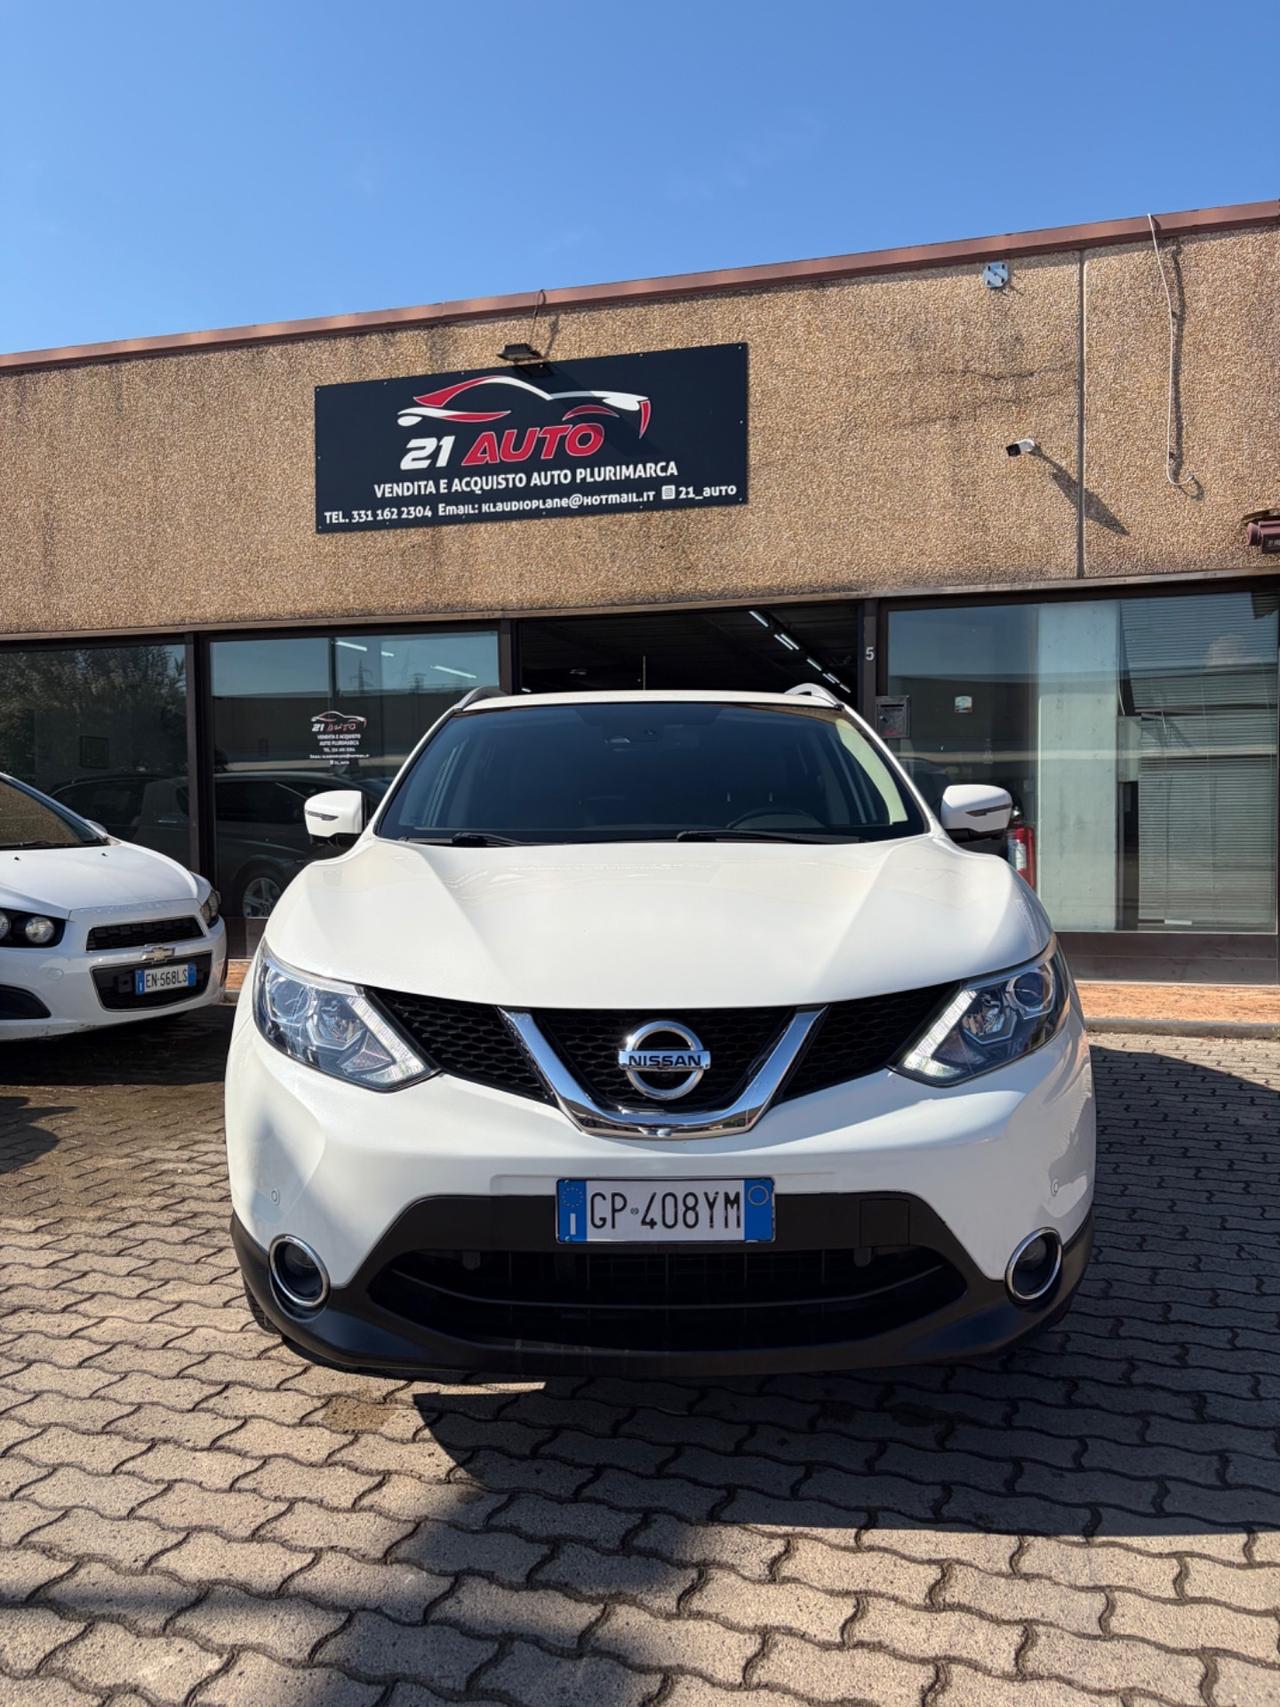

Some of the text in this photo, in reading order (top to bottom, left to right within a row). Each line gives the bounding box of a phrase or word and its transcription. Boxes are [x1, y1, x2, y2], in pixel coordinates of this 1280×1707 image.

[400, 422, 605, 471] 21 AUTO
[374, 461, 679, 499] VENDITA E ACQUISTO AUTO PLURIMARCA
[324, 511, 349, 524] TEL.
[351, 509, 373, 522] 331
[376, 508, 398, 520] 162
[400, 505, 432, 518] 2304
[865, 646, 875, 661] 5
[311, 723, 325, 732] 21
[145, 973, 157, 988] EN
[628, 1055, 701, 1067] NISSAN
[590, 1191, 742, 1229] GP 408YM
